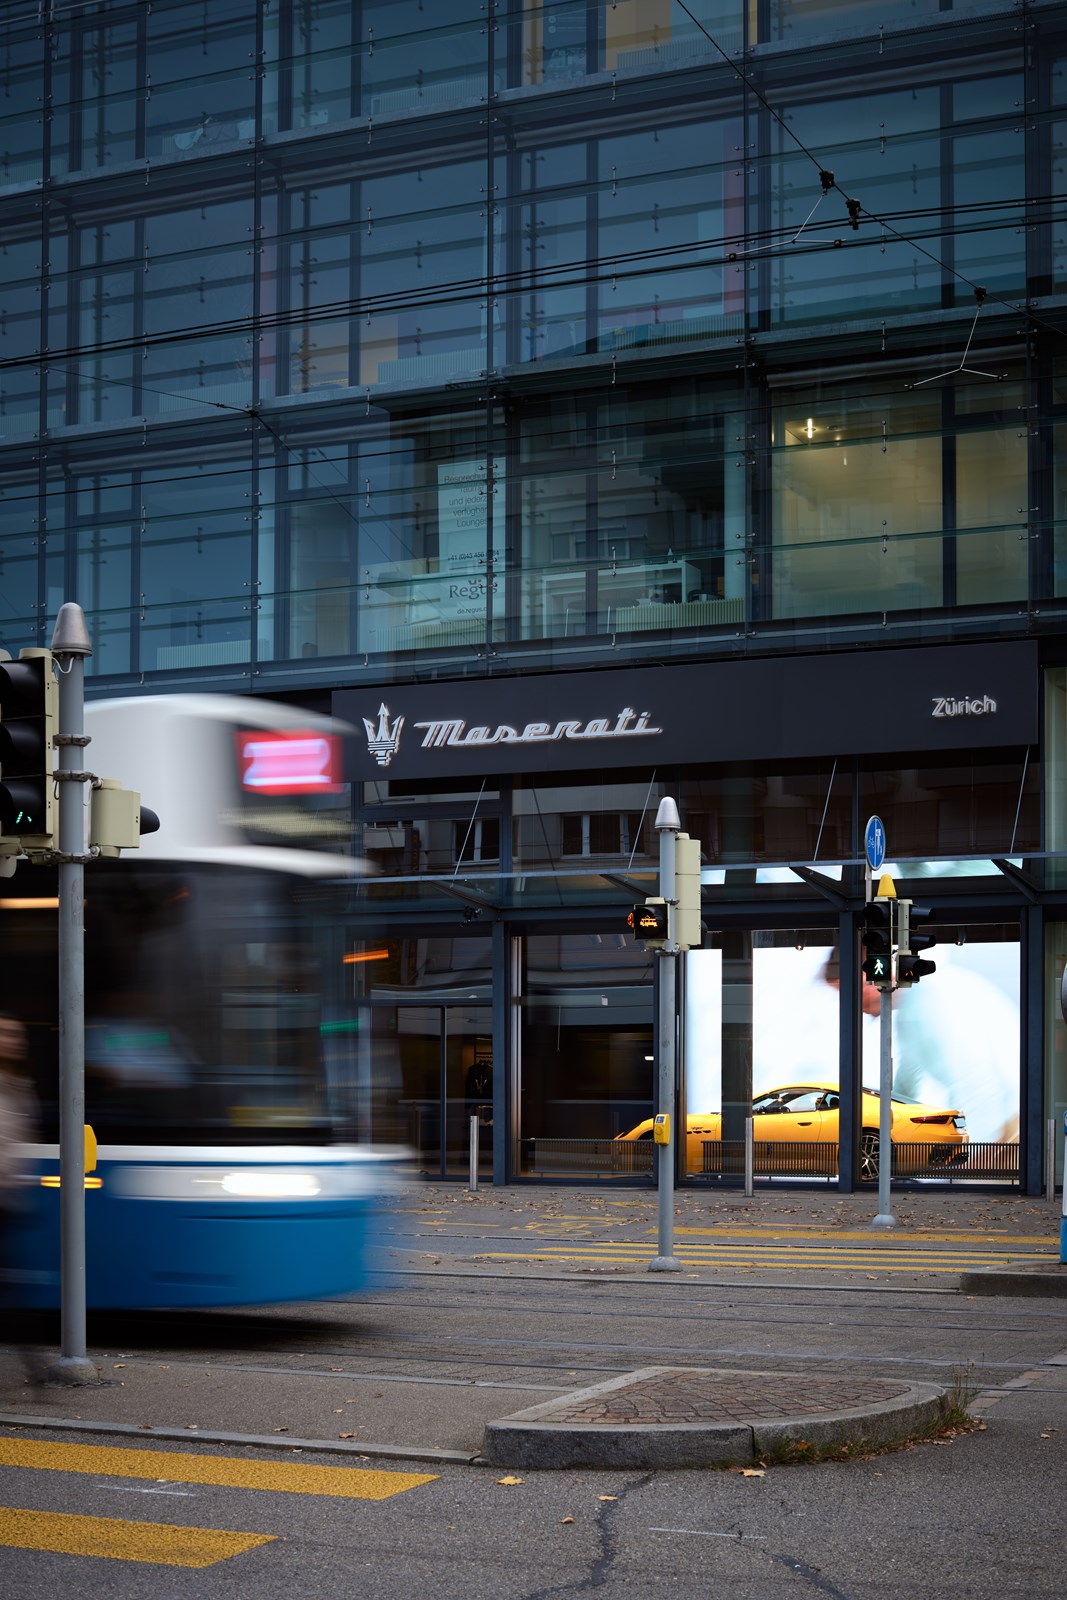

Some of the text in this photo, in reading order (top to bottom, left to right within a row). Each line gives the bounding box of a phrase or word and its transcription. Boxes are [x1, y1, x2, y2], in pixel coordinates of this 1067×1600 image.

[449, 496, 464, 506] und
[449, 580, 498, 600] Regus
[931, 694, 997, 717] Zürich
[413, 706, 663, 749] Maserati
